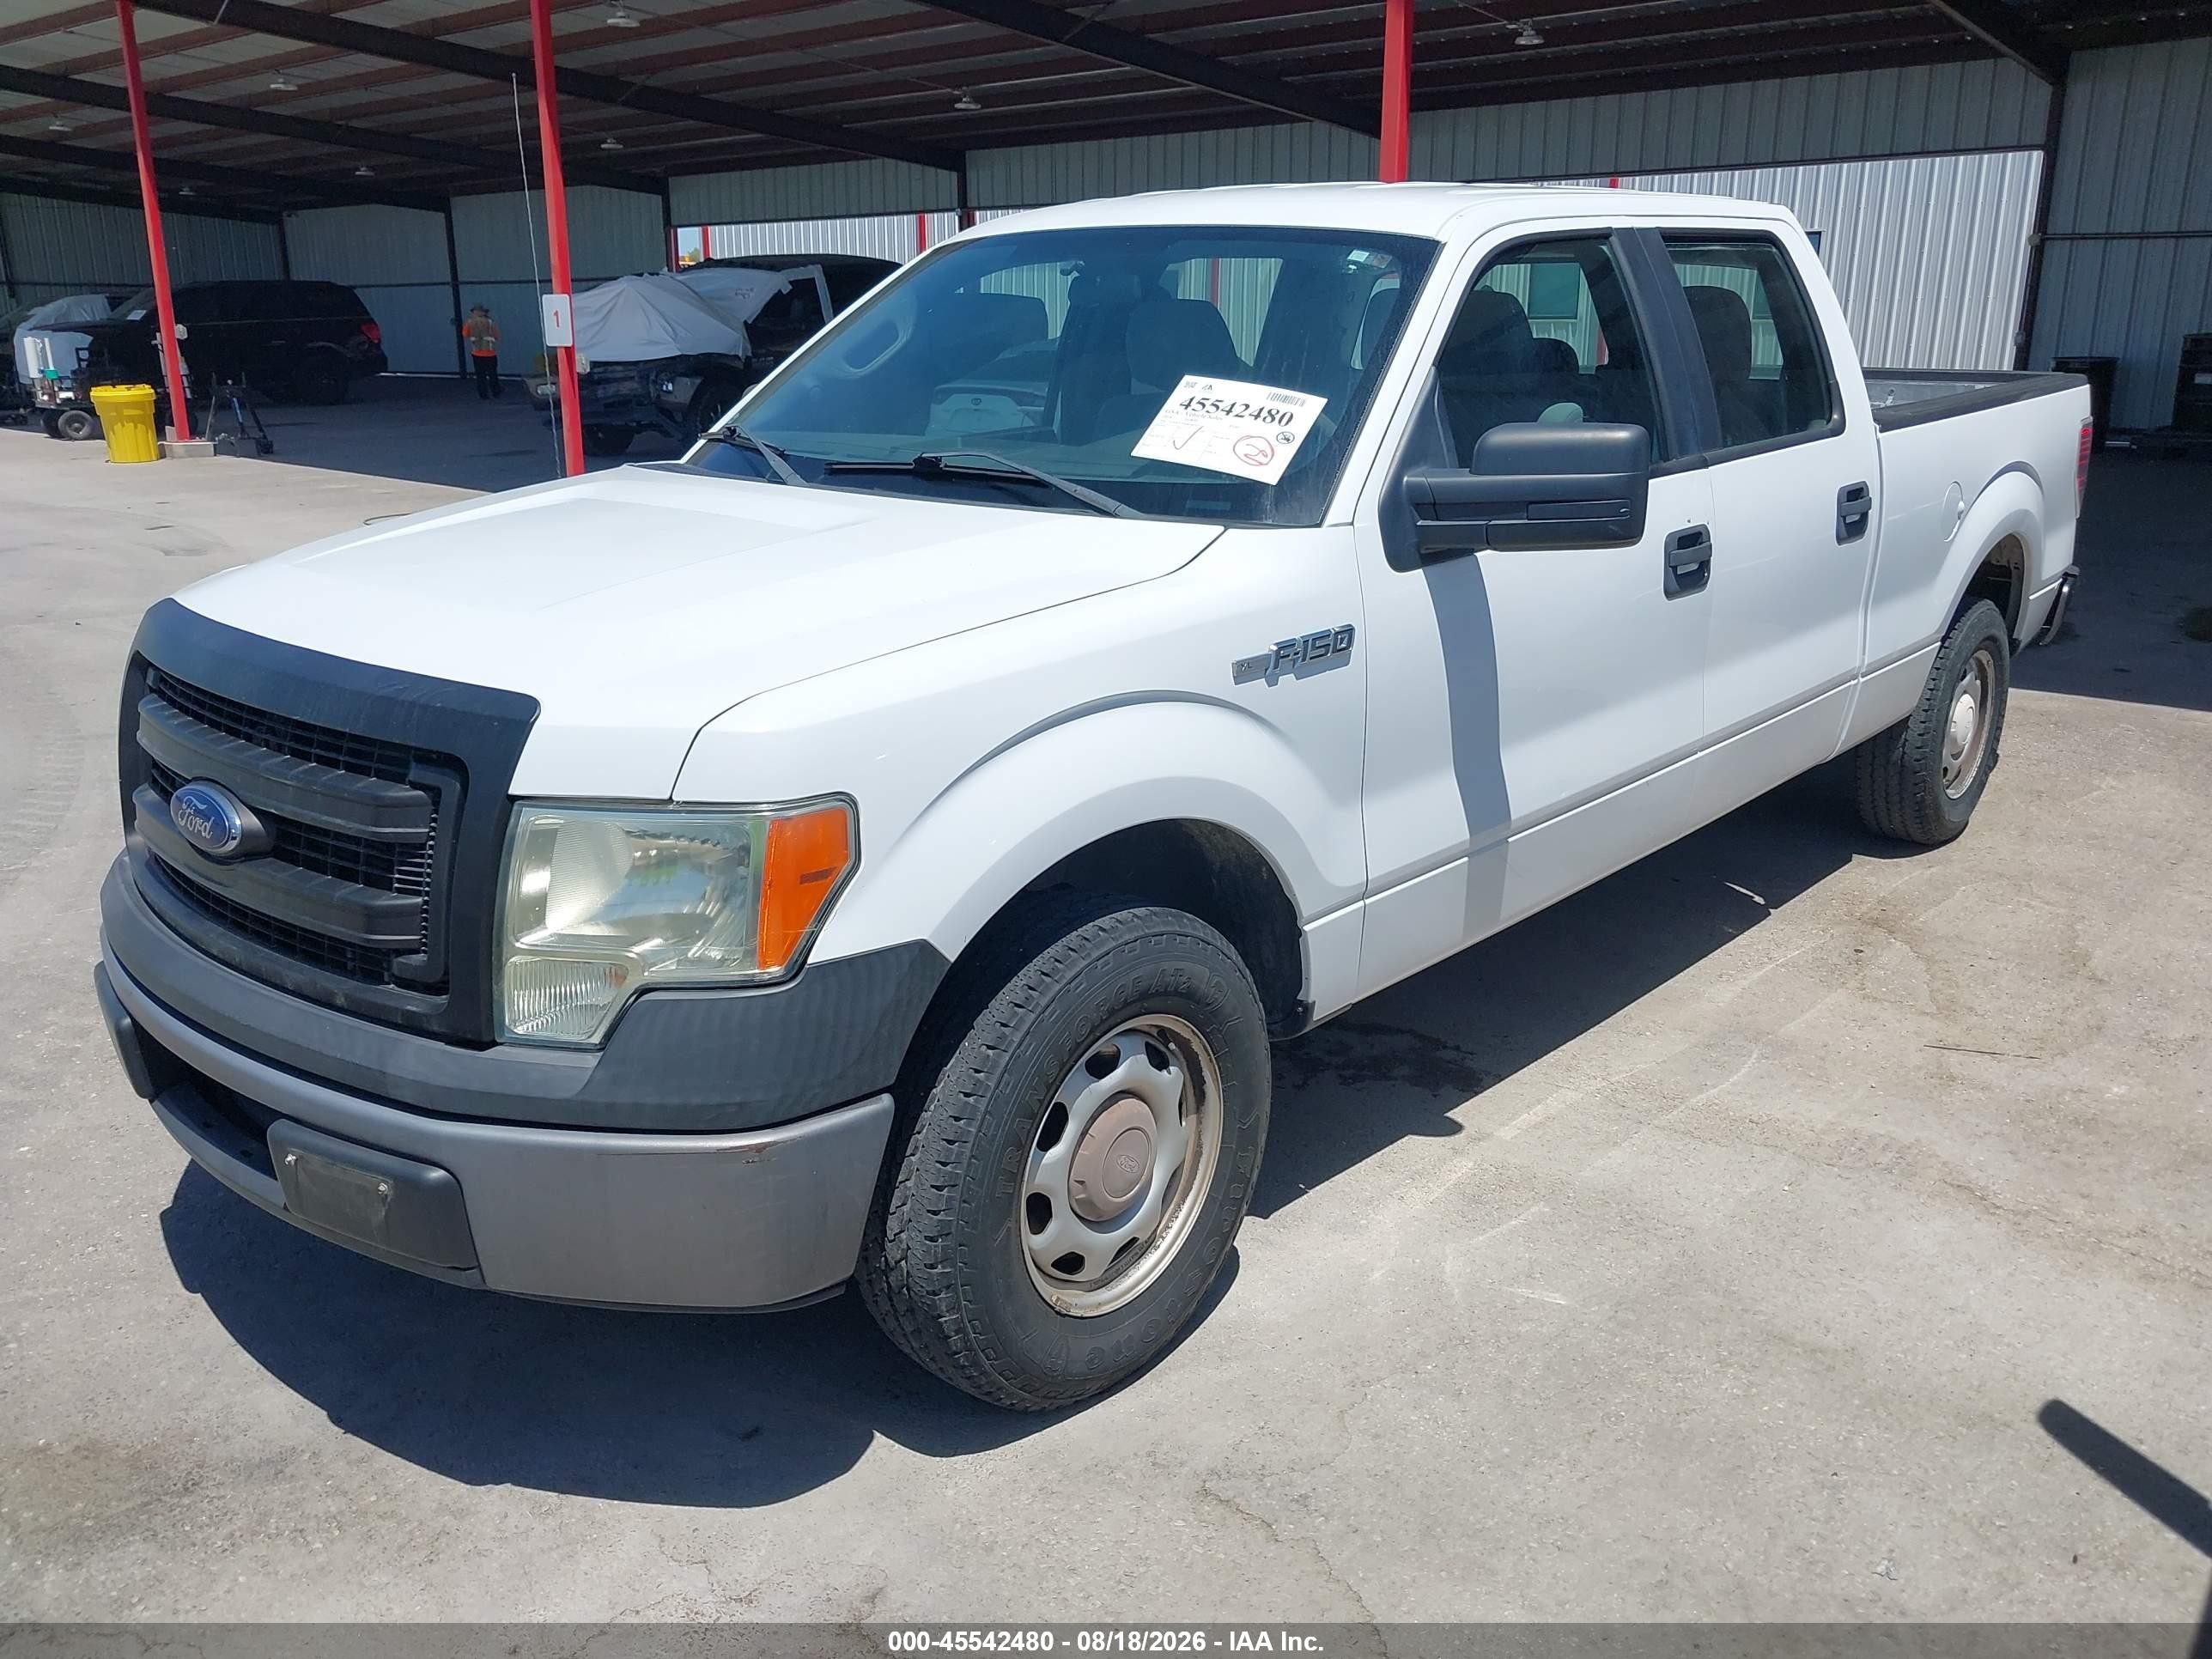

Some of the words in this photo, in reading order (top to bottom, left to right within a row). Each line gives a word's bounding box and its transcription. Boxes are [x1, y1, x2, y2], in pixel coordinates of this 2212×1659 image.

[553, 309, 560, 328] 1
[1179, 396, 1294, 427] 45542480
[1266, 624, 1356, 684] F-150
[178, 795, 216, 839] Ford
